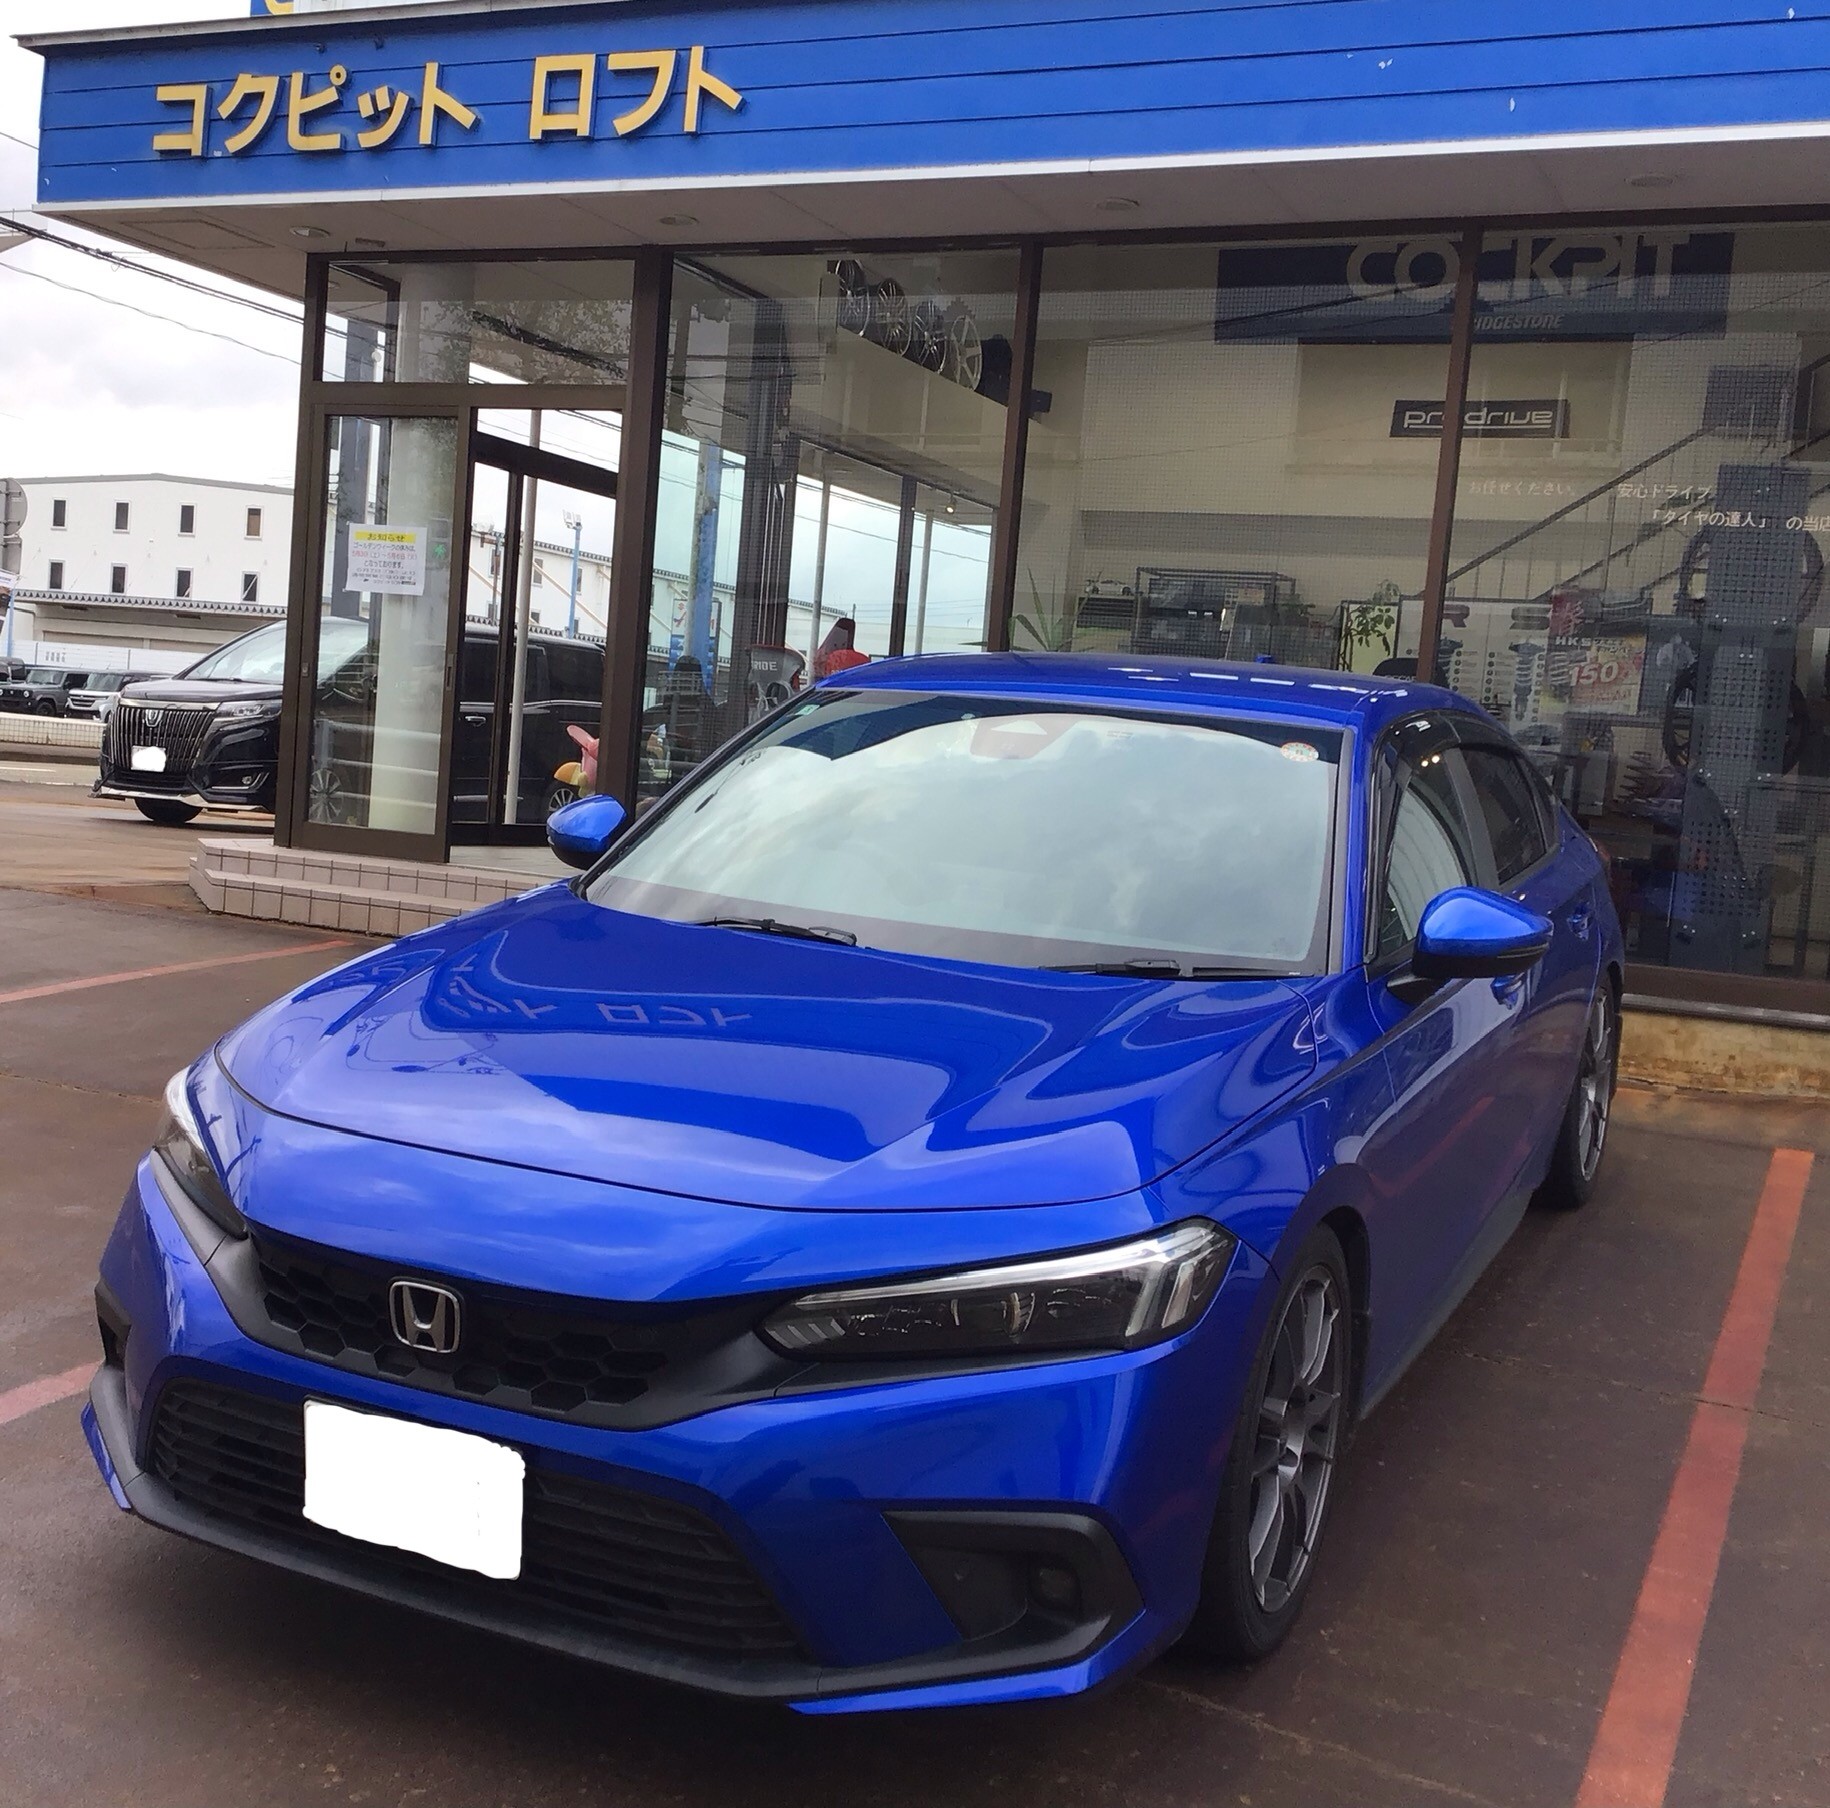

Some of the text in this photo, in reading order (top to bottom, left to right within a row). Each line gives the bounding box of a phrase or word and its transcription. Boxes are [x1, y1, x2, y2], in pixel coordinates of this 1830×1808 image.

[152, 46, 743, 156] コクピット ロフト
[1402, 407, 1553, 428] prdrive
[367, 532, 405, 542] お知らせ
